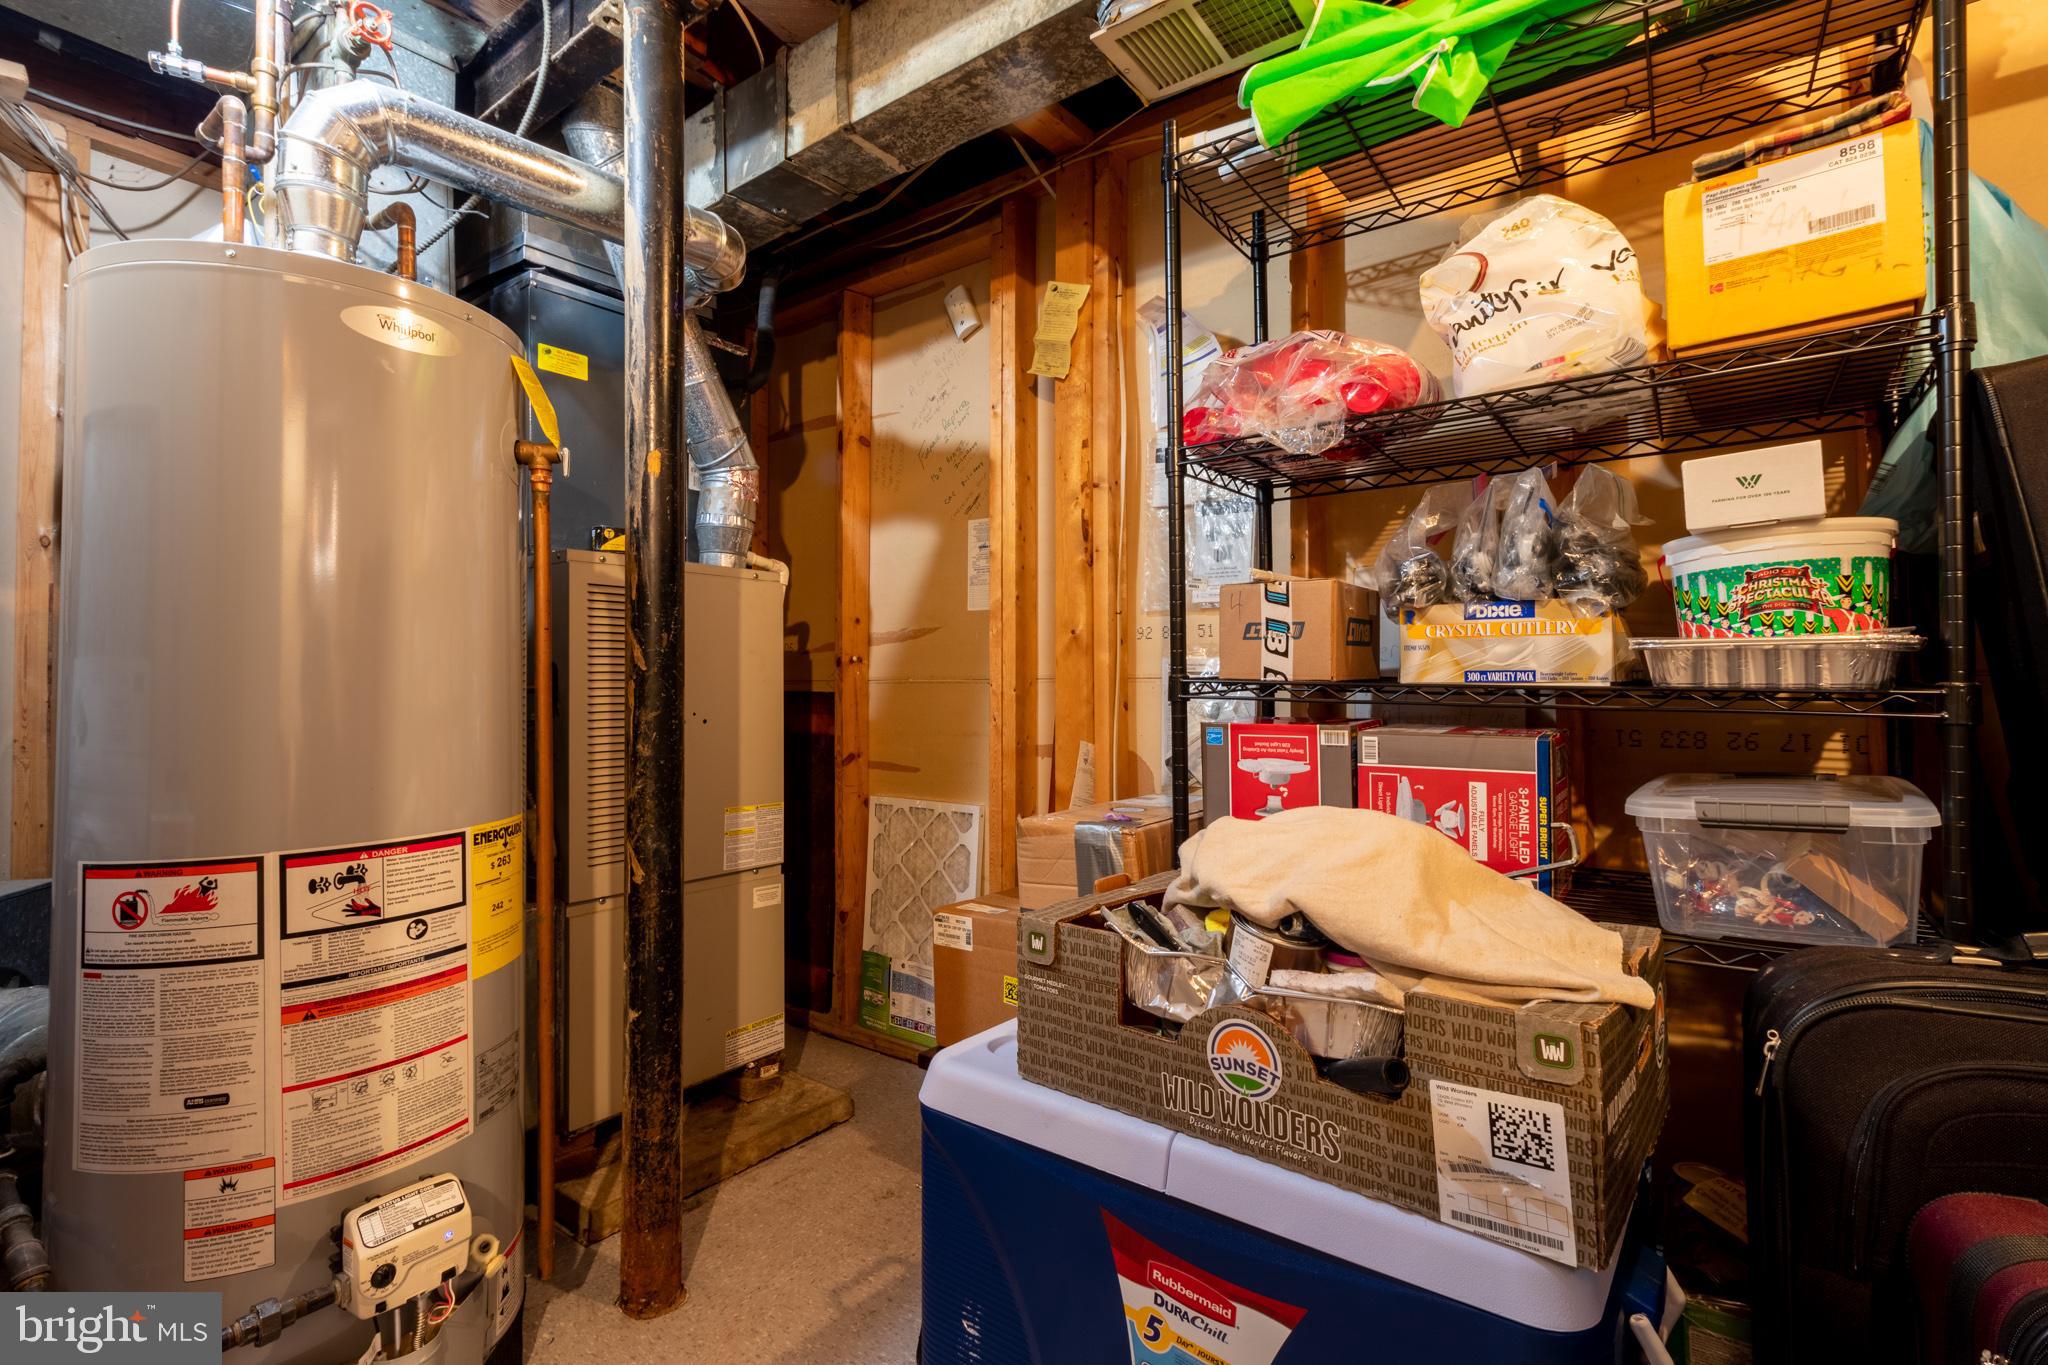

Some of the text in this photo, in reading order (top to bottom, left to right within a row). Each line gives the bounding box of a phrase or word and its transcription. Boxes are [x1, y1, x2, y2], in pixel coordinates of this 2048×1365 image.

[1840, 140, 1876, 158] 8598
[1828, 160, 1843, 168] CAT
[378, 316, 436, 343] Whirlpool
[1739, 577, 1820, 595] CHRISTMAS
[1728, 587, 1836, 613] SPECTACULAR
[1136, 626, 1152, 640] 92
[1198, 624, 1214, 638] 51
[1425, 619, 1580, 638] CRYSTAL CUTLERY
[1467, 672, 1480, 682] 300
[1488, 672, 1516, 682] VARIETY
[1516, 672, 1534, 682] PACK
[1615, 728, 1644, 748] 51
[1660, 730, 1708, 750] 833
[1727, 731, 1760, 752] 92
[1780, 733, 1812, 753] 17
[1508, 791, 1519, 860] GARAGE LIGHT
[1518, 787, 1530, 864] 3-PANEL LED
[1539, 796, 1548, 860] SUPER BRIGHT
[372, 846, 408, 858] DANGER
[497, 854, 512, 868] 263
[144, 869, 184, 878] WARNING
[492, 901, 504, 912] 242
[348, 956, 426, 978] IMPORTANT/IMPORTANTE
[1024, 974, 1046, 983] GOURMET
[1034, 984, 1059, 994] TOMATOES
[1472, 1006, 1516, 1028] WONDER
[1211, 1056, 1280, 1087] SUNSET
[1436, 1083, 1478, 1097] Wild Wonders
[1161, 1072, 1342, 1164] WILD WONDERS
[1190, 1116, 1308, 1162] Discover The World's Flavors
[212, 1164, 253, 1175] WARNING
[380, 1184, 435, 1209] STATUS LIGHT CODE
[438, 1208, 456, 1216] OUTLET
[212, 1222, 253, 1236] WARNING
[1152, 1269, 1232, 1320] Rubbermaid
[1144, 1314, 1164, 1342] 5
[1153, 1292, 1228, 1345] DURAChill
